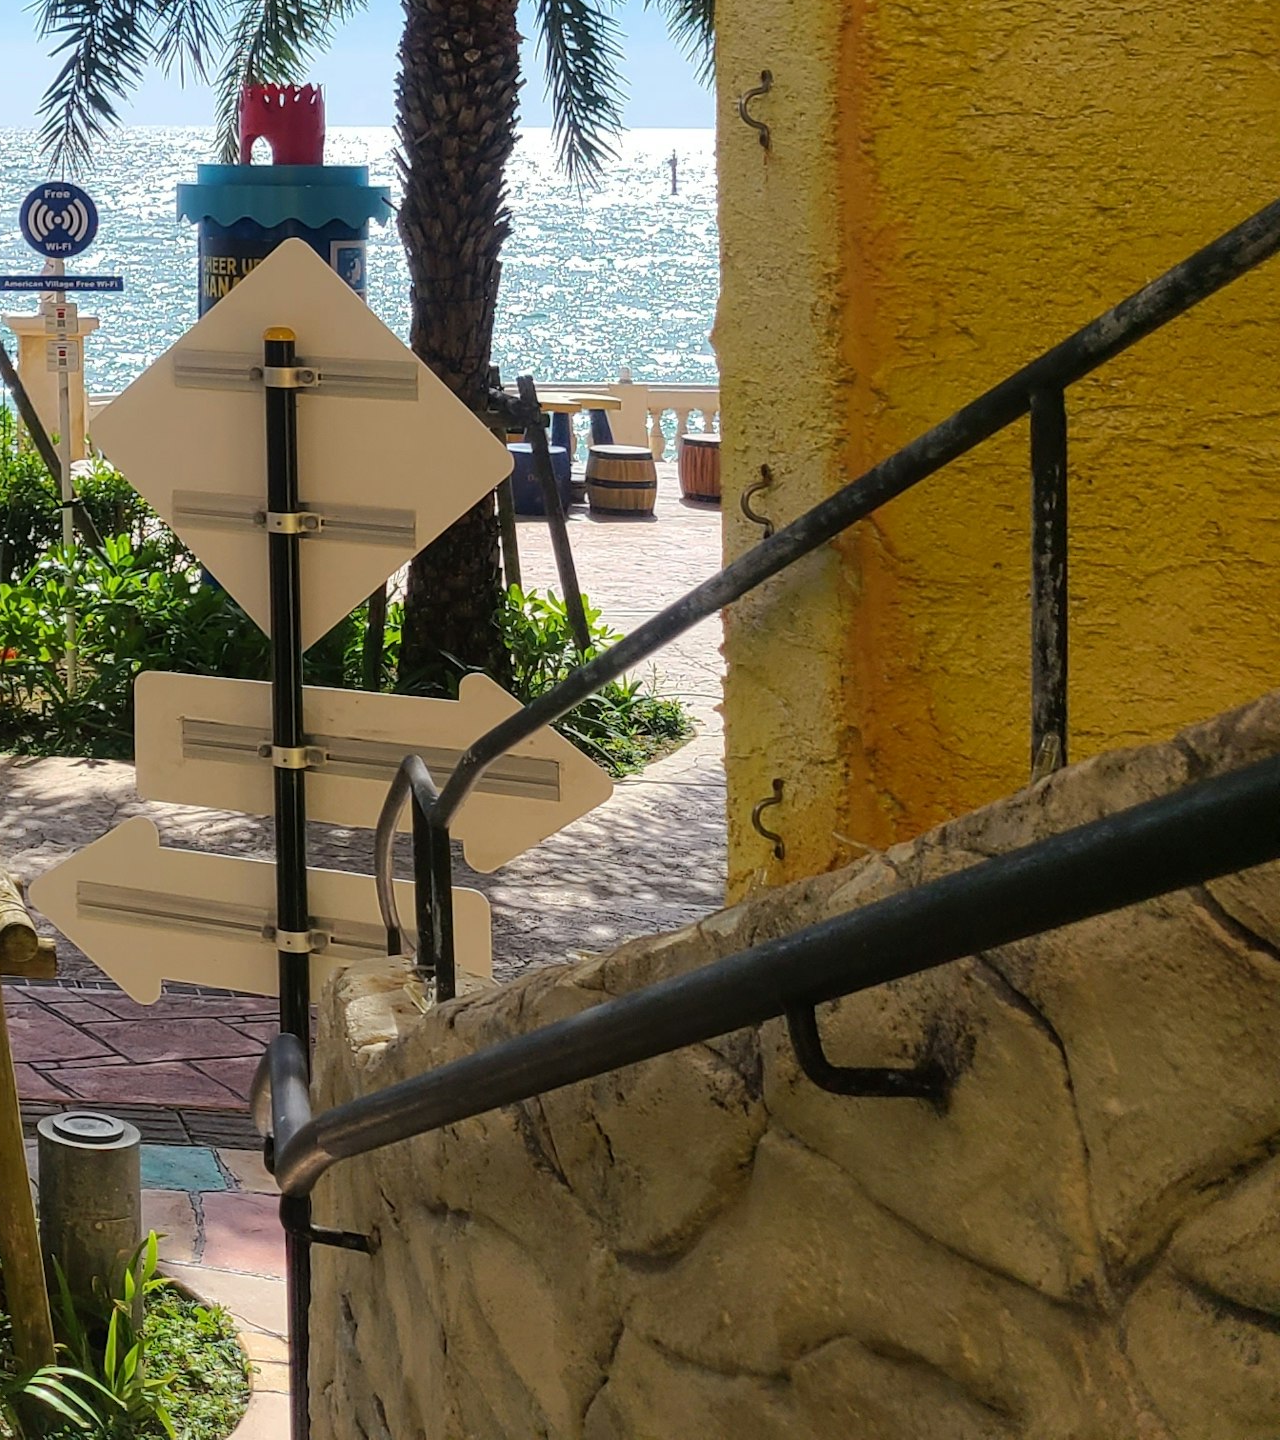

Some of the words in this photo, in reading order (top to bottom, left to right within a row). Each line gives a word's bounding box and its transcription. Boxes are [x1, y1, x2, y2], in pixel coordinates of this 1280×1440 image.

[44, 189, 70, 199] Free
[45, 243, 72, 251] Wi-Fi
[4, 280, 44, 288] American
[45, 280, 74, 289] Village
[75, 280, 95, 288] Free
[96, 280, 118, 288] Wi-Fi
